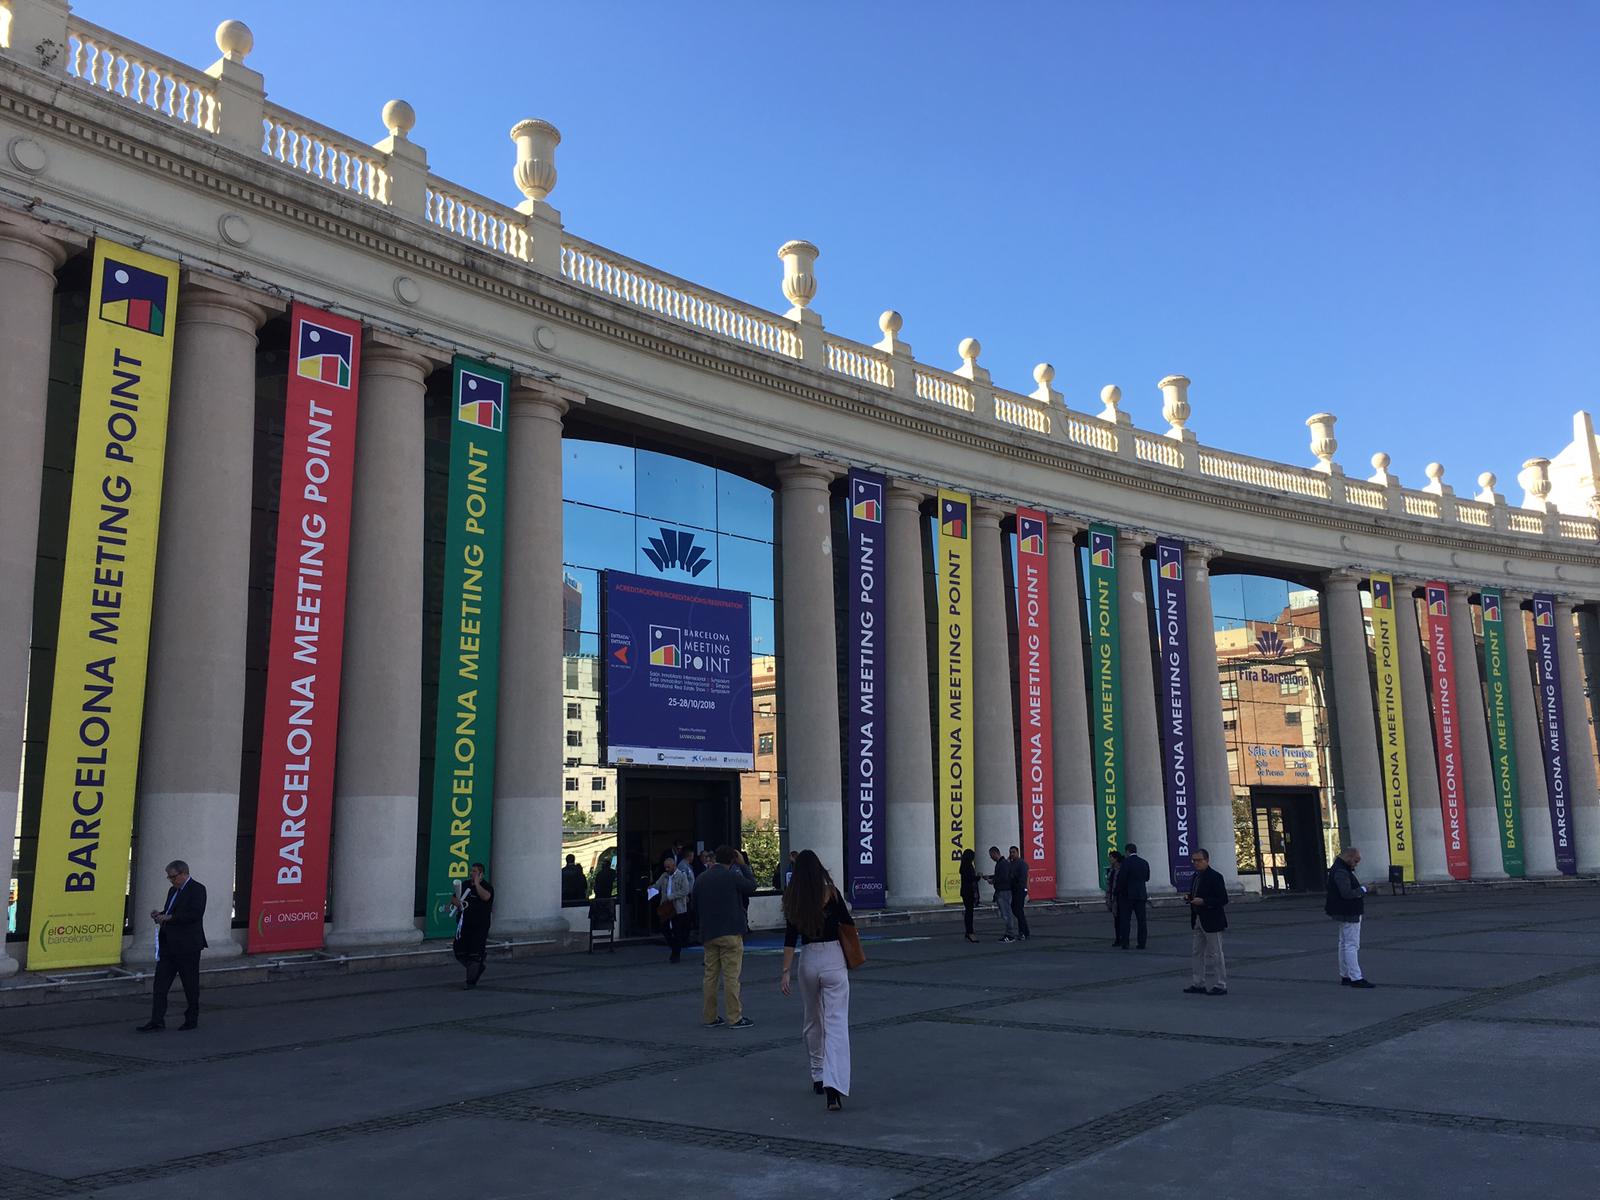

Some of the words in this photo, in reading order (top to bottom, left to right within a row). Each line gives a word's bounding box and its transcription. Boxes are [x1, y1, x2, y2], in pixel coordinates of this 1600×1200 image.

[106, 348, 141, 463] POINT
[304, 400, 332, 502] POINT
[466, 442, 488, 534] POINT
[89, 476, 131, 644] MEETING
[294, 514, 326, 664] MEETING
[861, 533, 874, 603] POINT
[949, 550, 961, 615] POINT
[1027, 565, 1039, 627] POINT
[459, 545, 484, 680] MEETING
[684, 629, 730, 642] BARCELONA
[684, 641, 730, 656] MEETING
[1098, 577, 1110, 637] POINT
[1166, 588, 1180, 646] POINT
[1380, 619, 1392, 667] POINT
[1435, 624, 1447, 672] POINT
[684, 654, 730, 674] POINT
[861, 612, 874, 714] MEETING
[950, 624, 962, 720] MEETING
[1029, 635, 1041, 726] MEETING
[1100, 644, 1115, 731] MEETING
[1169, 651, 1184, 736] MEETING
[1240, 669, 1258, 681] Fira
[1261, 669, 1309, 686] Barcelona
[1490, 630, 1502, 676] POINT
[1542, 635, 1554, 679] POINT
[668, 697, 716, 710] 25-28/10/2018
[1385, 674, 1398, 746] MEETING
[1440, 678, 1453, 748] MEETING
[1494, 682, 1508, 750] MEETING
[1547, 685, 1560, 751] MEETING
[65, 657, 116, 892] BARCELONA
[278, 675, 315, 884] BARCELONA
[449, 690, 477, 879] BARCELONA
[860, 722, 874, 864] BARCELONA
[951, 728, 964, 861] BARCELONA
[1269, 746, 1280, 757] de
[1031, 733, 1045, 859] BARCELONA
[1174, 742, 1189, 856] BARCELONA
[1391, 752, 1406, 851] BARCELONA
[1446, 753, 1461, 849] BARCELONA
[1500, 755, 1516, 849] BARCELONA
[1553, 756, 1568, 846] BARCELONA
